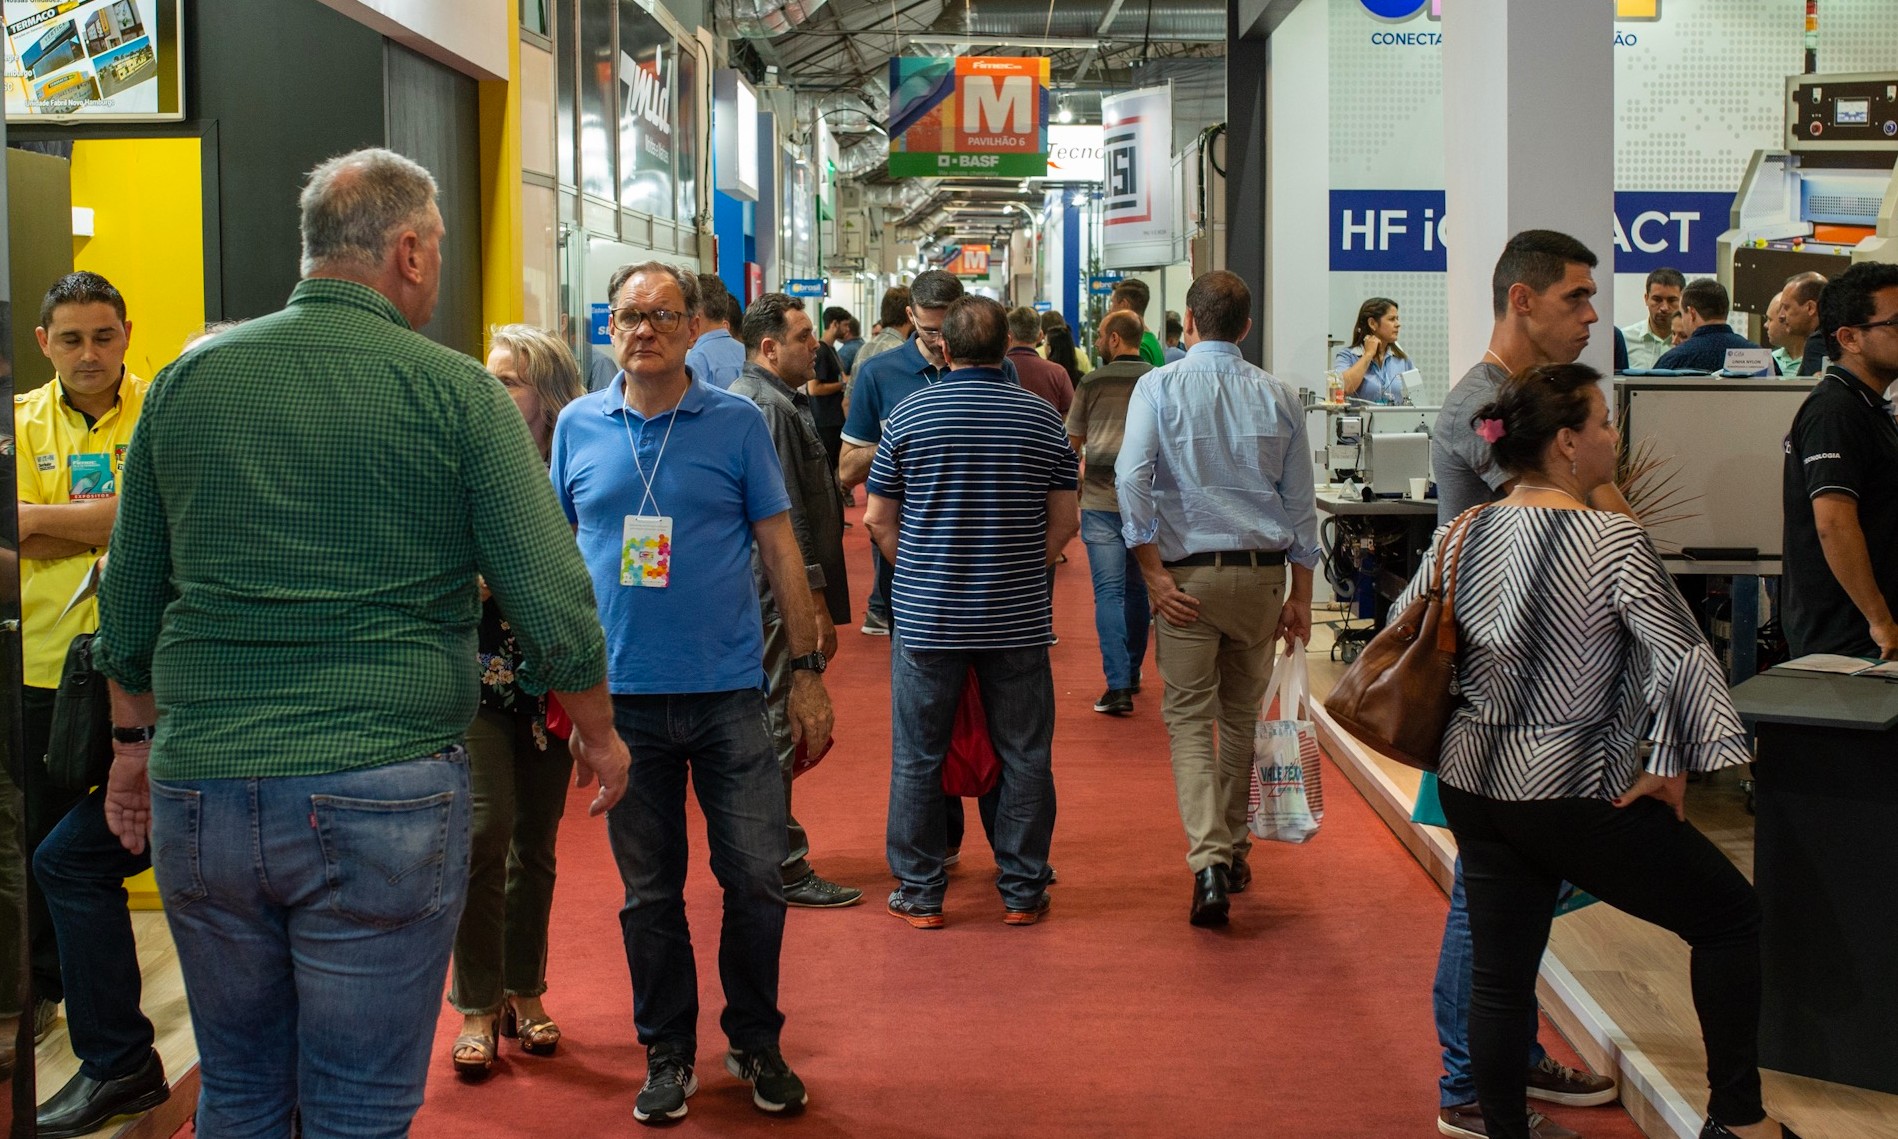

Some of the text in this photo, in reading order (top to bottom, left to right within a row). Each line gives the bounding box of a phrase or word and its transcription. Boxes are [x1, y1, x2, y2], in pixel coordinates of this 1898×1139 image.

[10, 8, 56, 34] TERMACO
[963, 75, 1033, 134] M
[968, 135, 1026, 147] PAVILHÃO 6
[959, 155, 1000, 168] BASF
[1342, 208, 1447, 251] HF i
[964, 250, 986, 269] M
[1260, 766, 1282, 782] VALE
